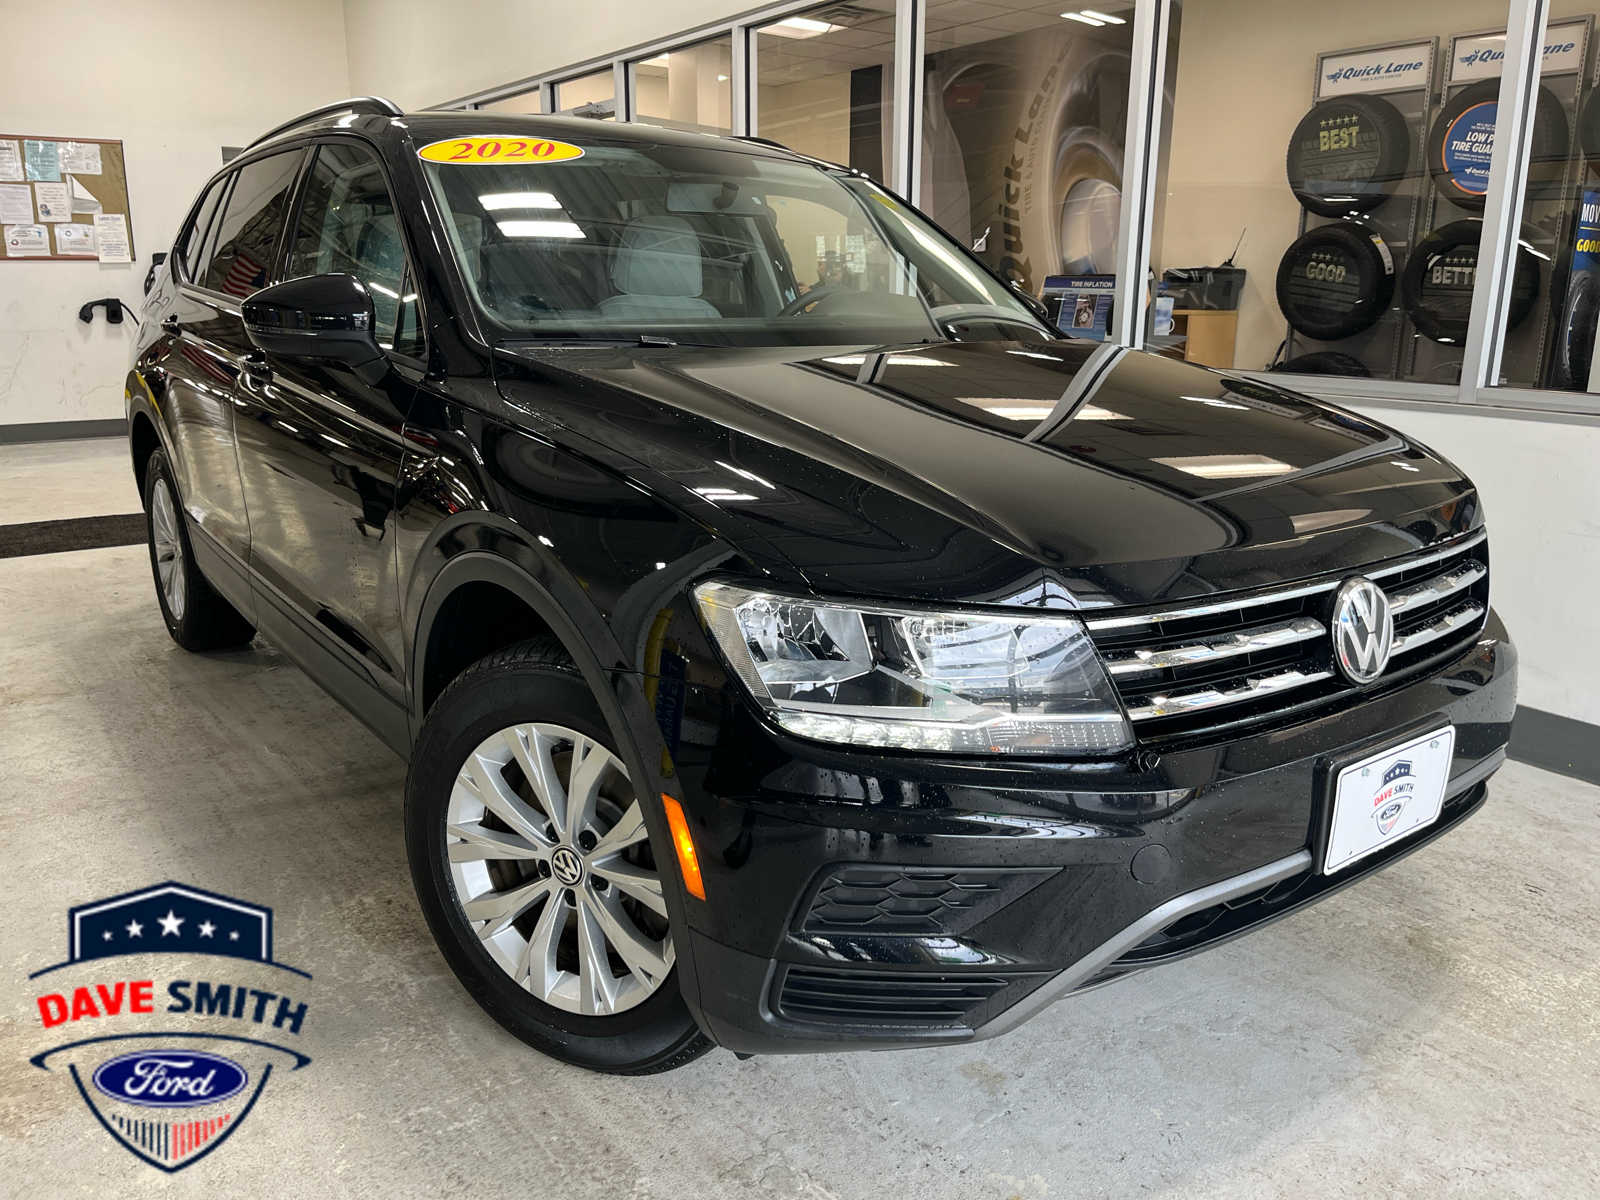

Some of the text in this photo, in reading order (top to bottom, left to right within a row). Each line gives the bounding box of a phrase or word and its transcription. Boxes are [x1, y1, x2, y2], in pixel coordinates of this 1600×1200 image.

[1343, 64, 1383, 79] Quick
[1384, 61, 1423, 74] Lane
[1319, 126, 1360, 152] BEST
[1451, 141, 1472, 151] TIRE
[1466, 131, 1488, 143] LOW
[449, 141, 555, 160] 2020
[1581, 203, 1600, 223] MOV
[1306, 261, 1346, 283] GOOD
[1432, 266, 1476, 285] BETT
[1374, 783, 1414, 807] DAVE SMITH
